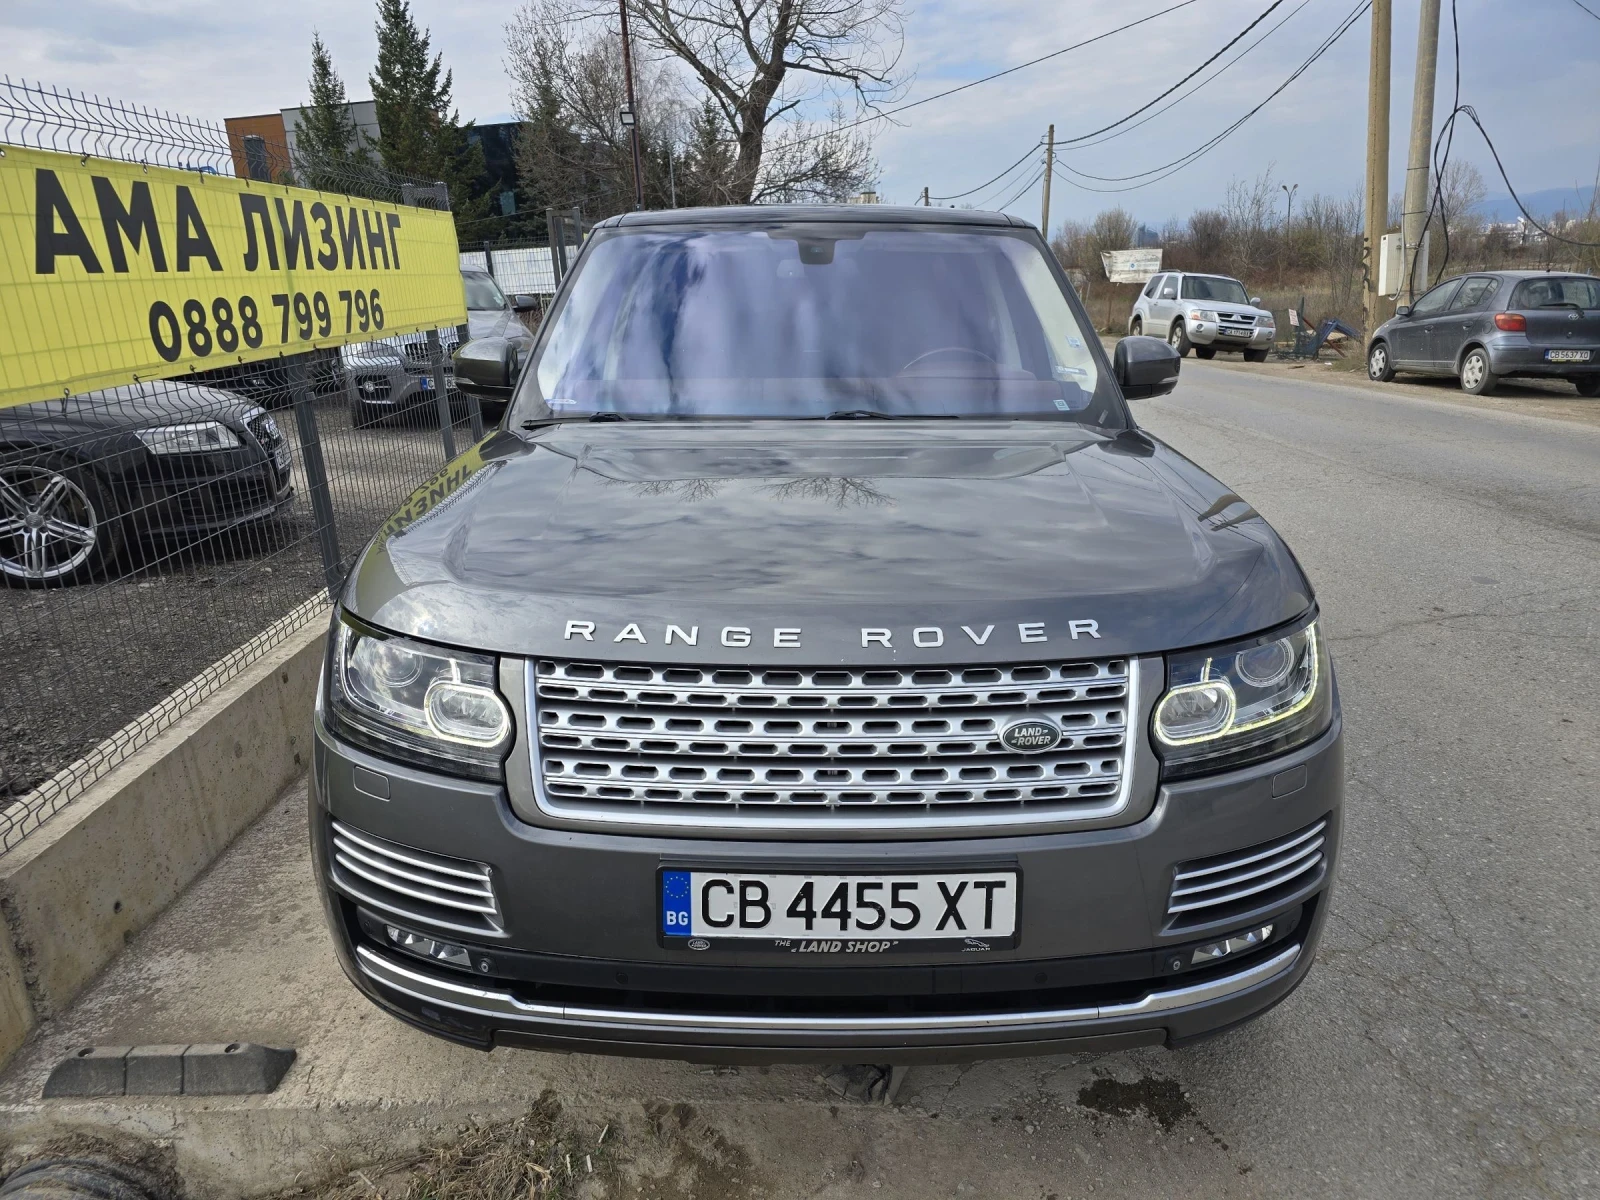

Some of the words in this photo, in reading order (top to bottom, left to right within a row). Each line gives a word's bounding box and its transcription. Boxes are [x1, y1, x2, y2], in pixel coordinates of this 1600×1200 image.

[36, 168, 224, 275] АМА
[238, 192, 402, 272] ЛИЗИНГ
[149, 295, 263, 362] 0888
[271, 291, 332, 344] 799
[338, 288, 385, 334] 796
[1550, 350, 1560, 359] CB
[1560, 350, 1579, 359] 5637
[563, 618, 802, 650] RANGE
[861, 617, 1102, 650] ROVER
[1014, 727, 1042, 737] LAND
[1017, 735, 1051, 746] ROVER
[666, 911, 689, 925] BG
[701, 878, 772, 929] CB
[786, 881, 921, 931] 4455
[935, 880, 1007, 931] XT
